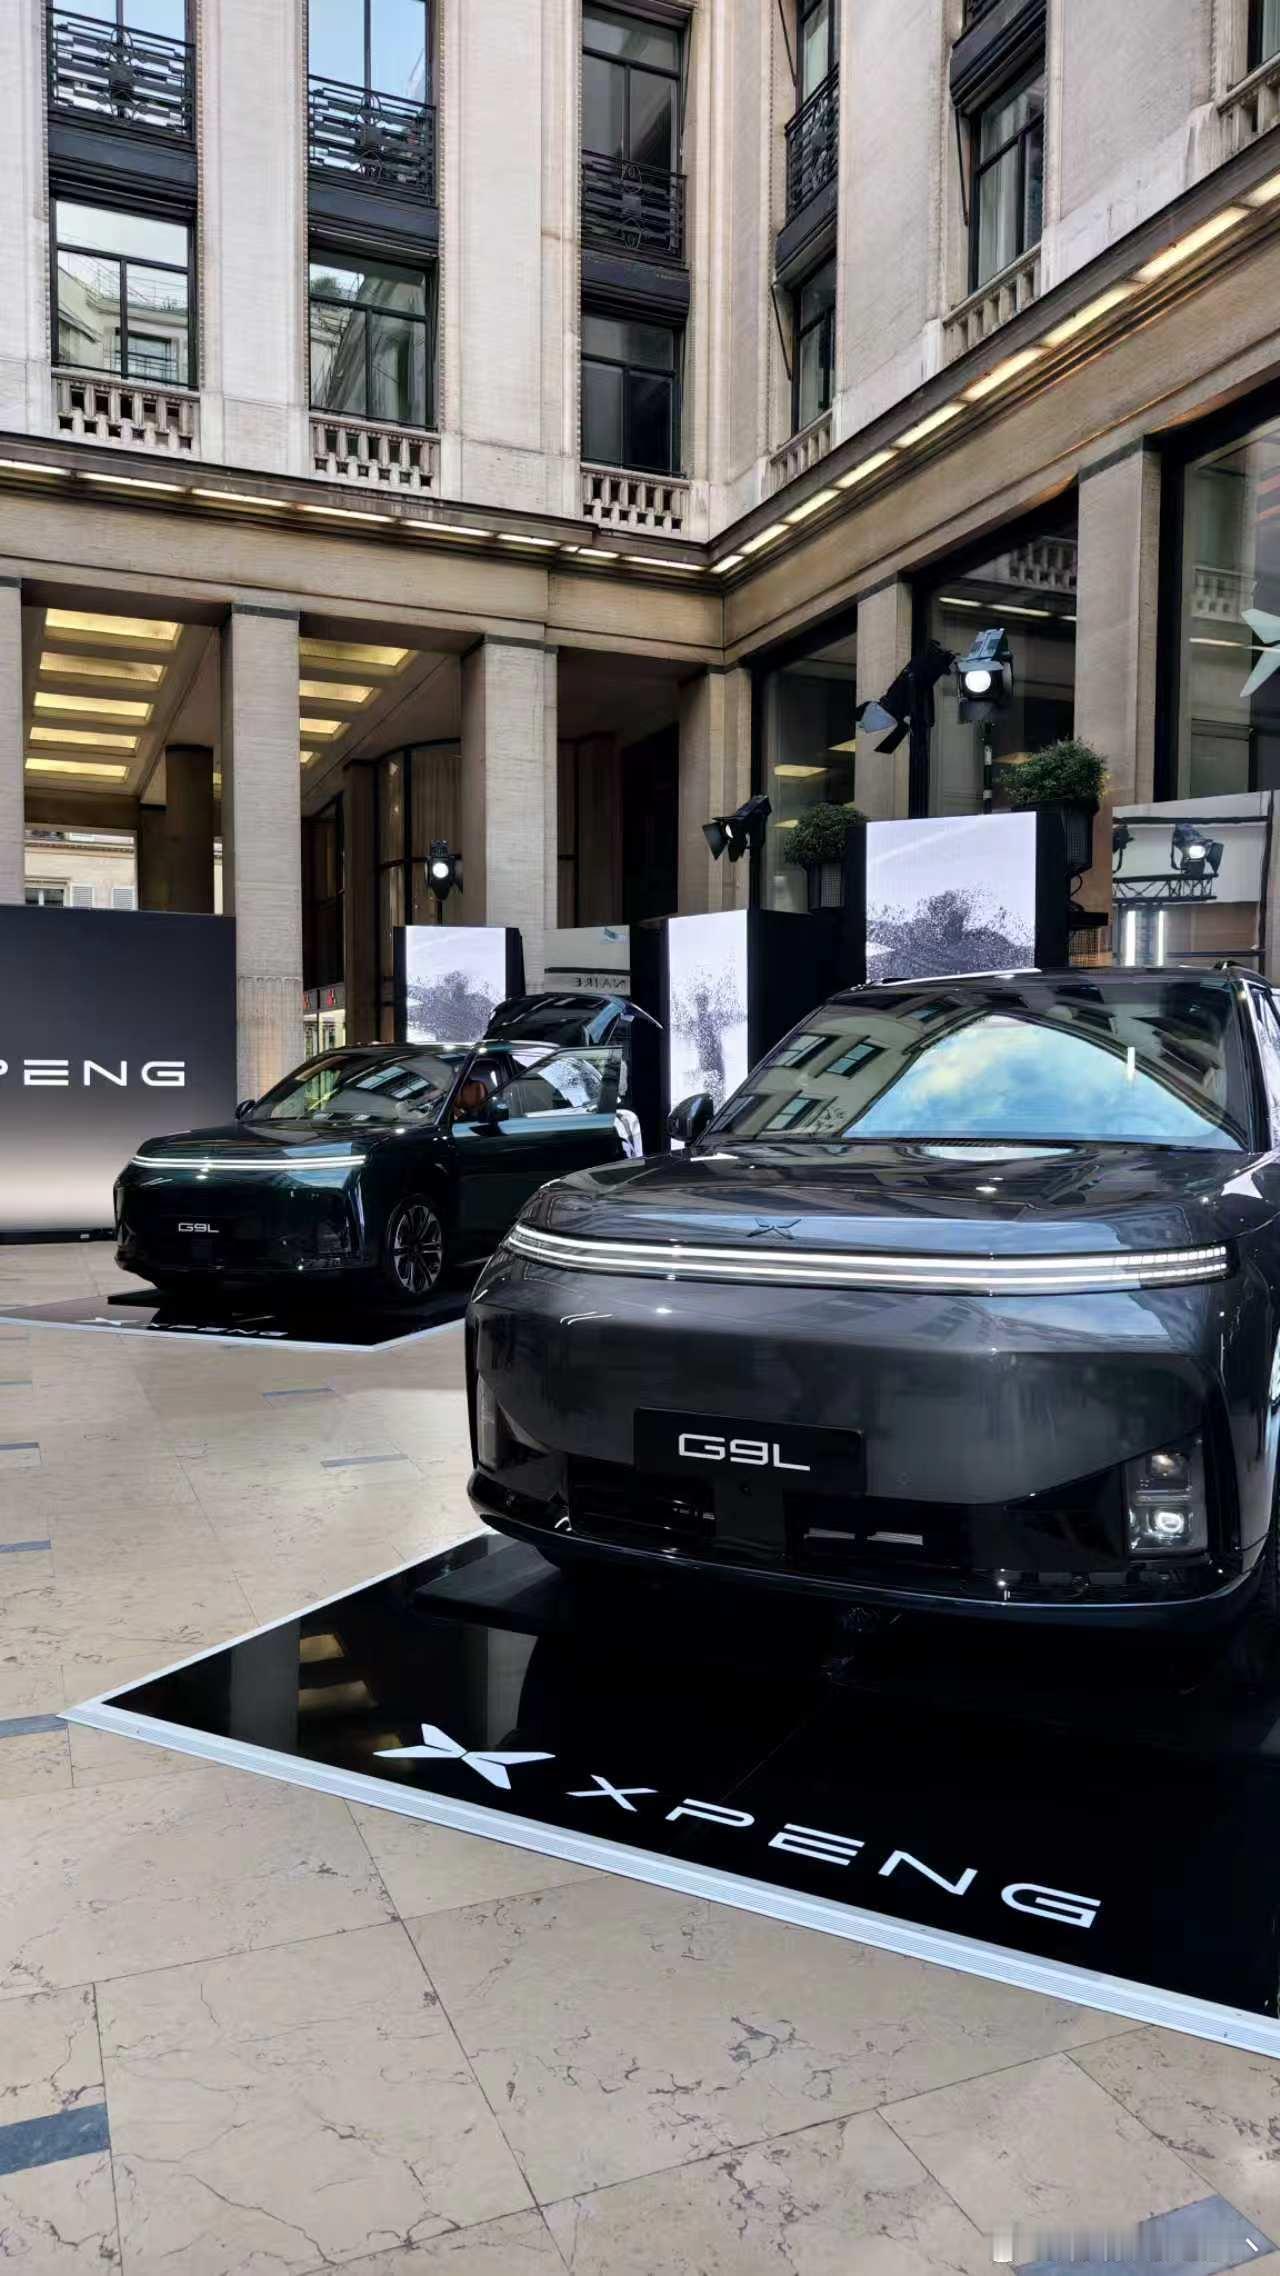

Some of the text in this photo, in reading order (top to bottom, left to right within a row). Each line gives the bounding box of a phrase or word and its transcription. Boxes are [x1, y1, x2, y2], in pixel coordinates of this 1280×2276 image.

[0, 1060, 185, 1087] ENG
[178, 1222, 220, 1234] G9L
[678, 1433, 811, 1471] G9L
[565, 1774, 1102, 1930] XPENG
